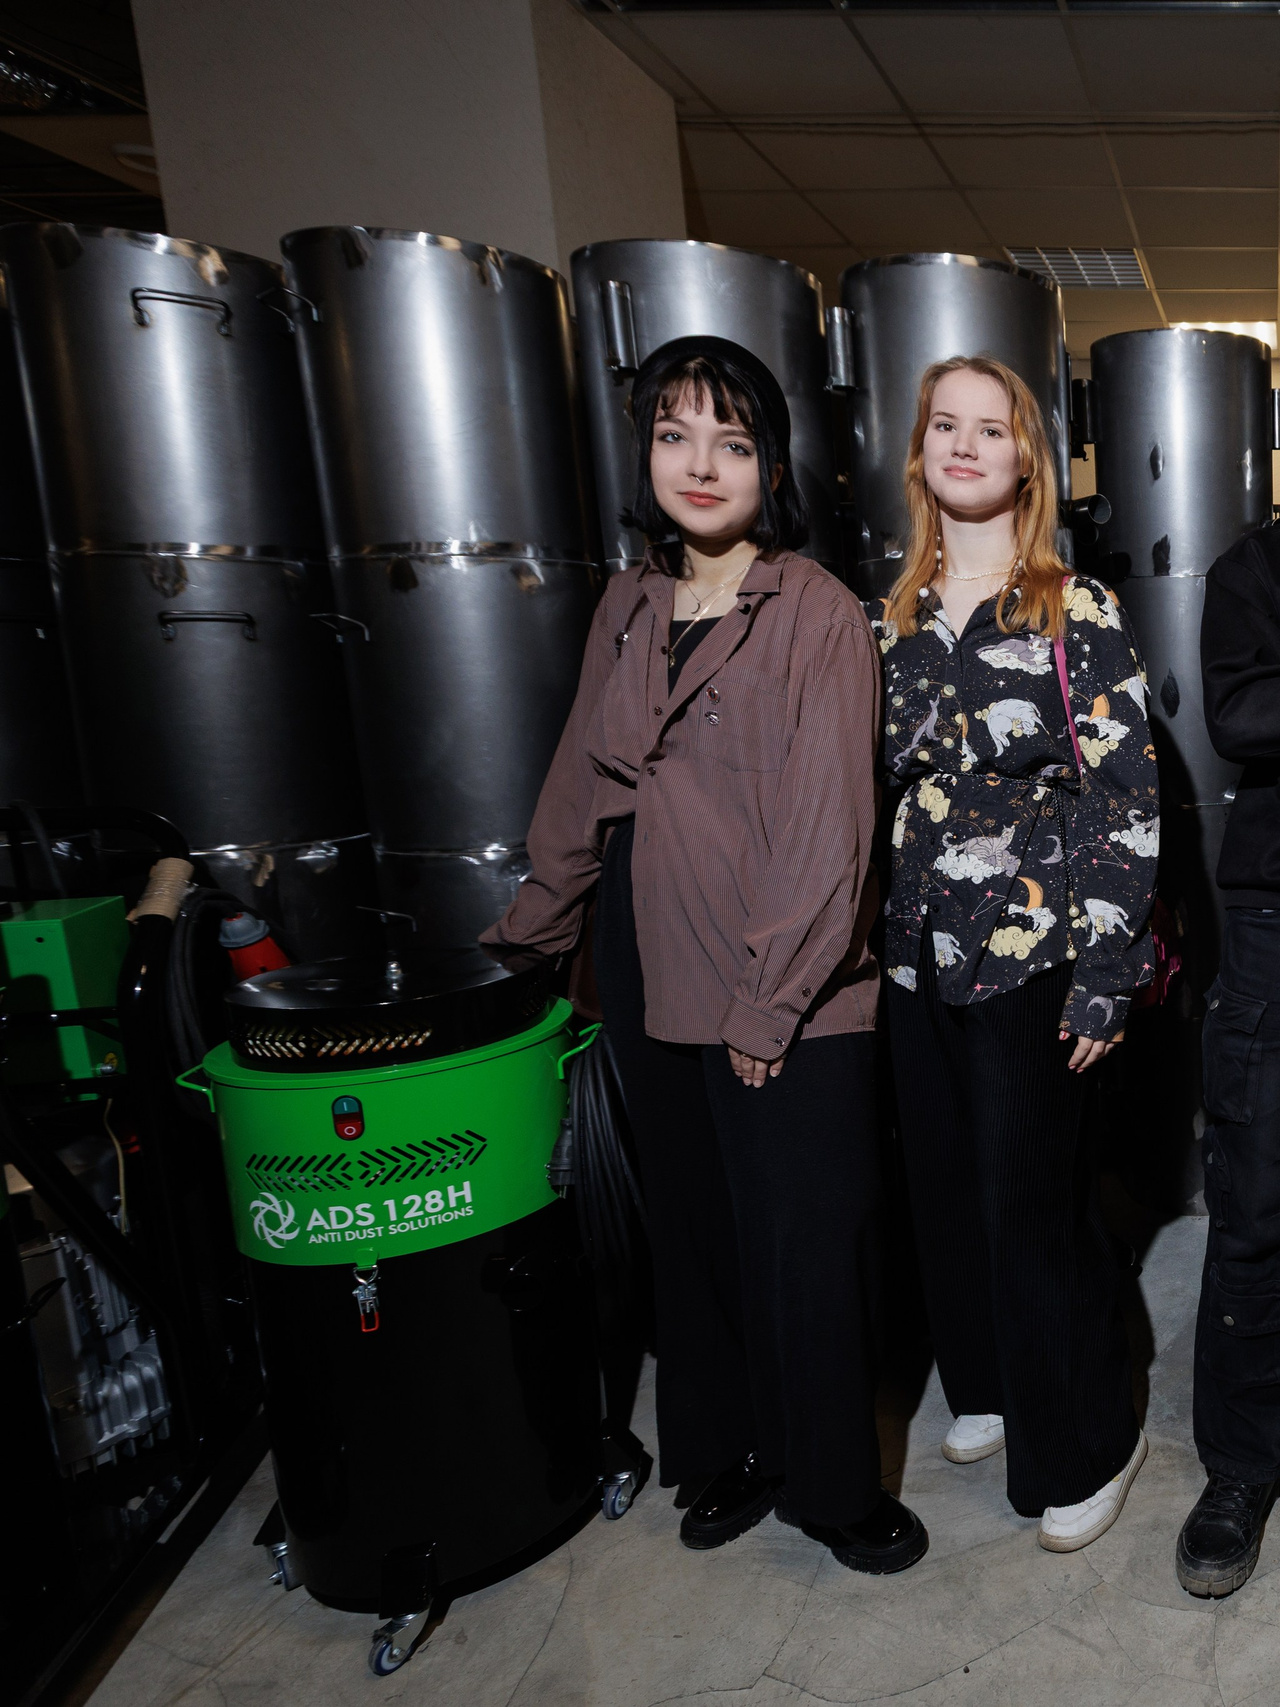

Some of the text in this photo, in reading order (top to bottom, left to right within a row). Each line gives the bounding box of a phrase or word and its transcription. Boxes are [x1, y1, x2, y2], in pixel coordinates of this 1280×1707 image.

[307, 1181, 473, 1231] ADS 128H
[309, 1206, 474, 1244] ANTI DUST SOLUTIONS
